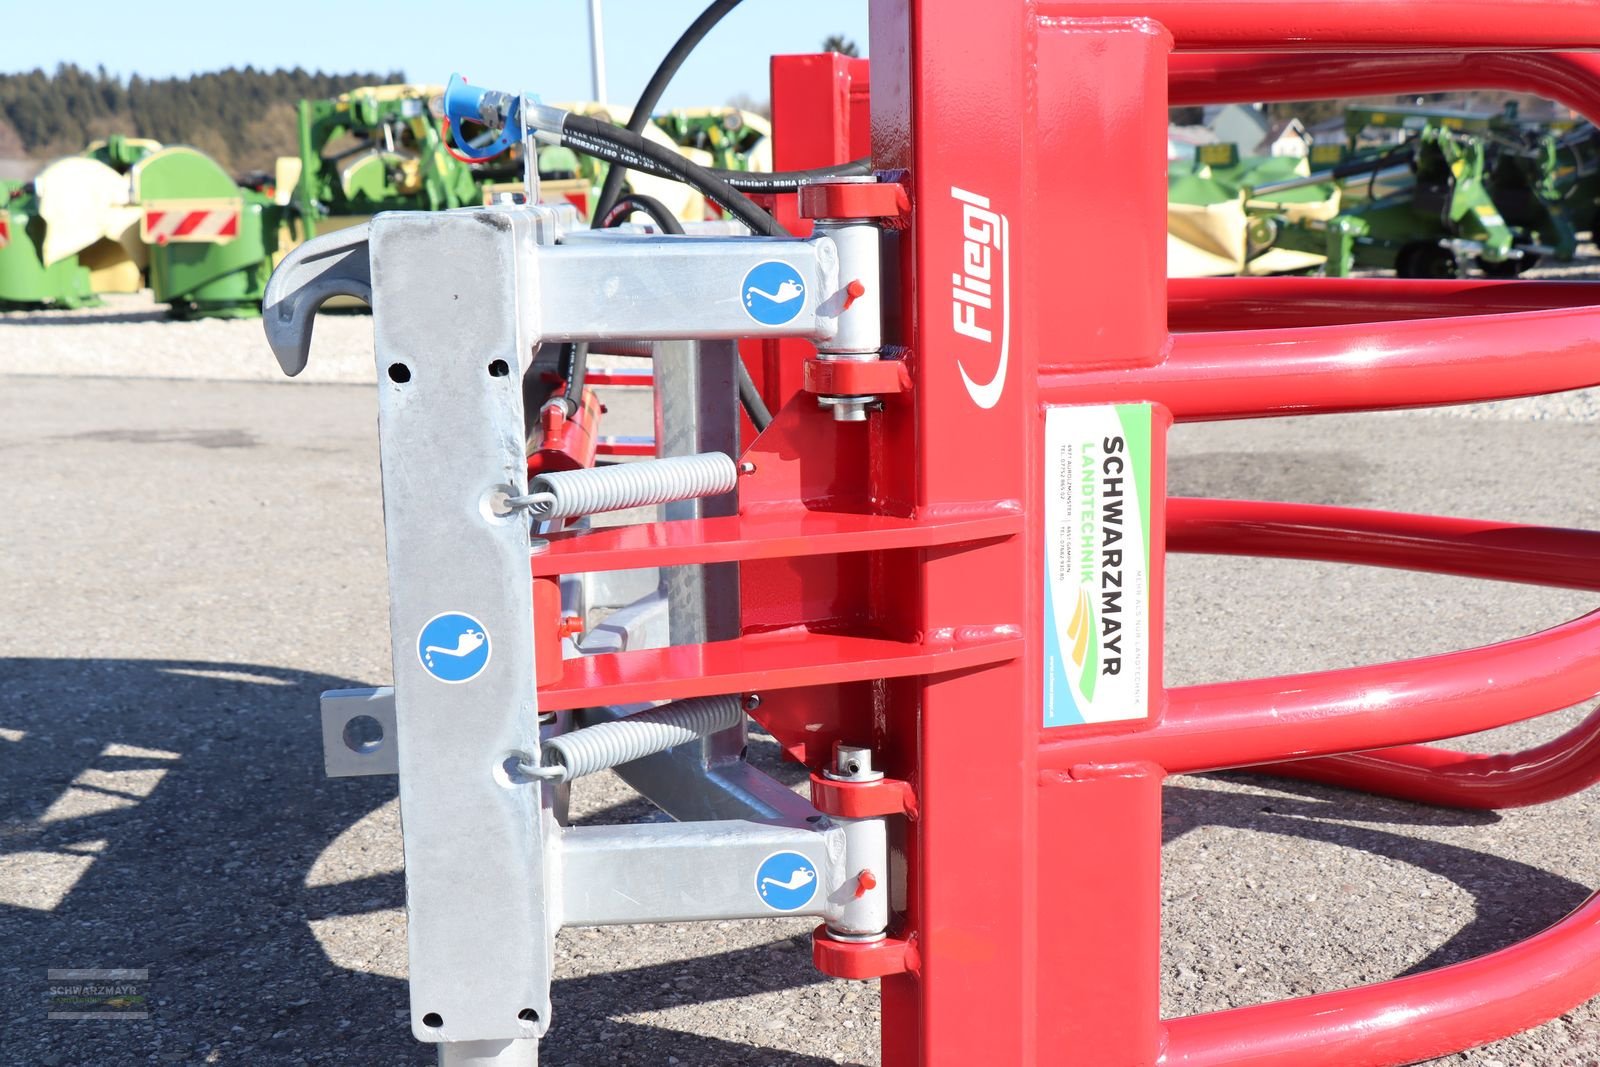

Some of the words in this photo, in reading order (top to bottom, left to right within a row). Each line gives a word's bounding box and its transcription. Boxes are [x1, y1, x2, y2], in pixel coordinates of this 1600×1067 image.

[568, 136, 600, 152] 100R2AT
[604, 148, 618, 158] ISO
[620, 153, 638, 164] 1436
[730, 178, 768, 187] Resistant
[951, 186, 1001, 342] Fliegl
[1080, 442, 1095, 584] LANDTECHNIK
[1102, 436, 1124, 676] SCHWARZMAYR
